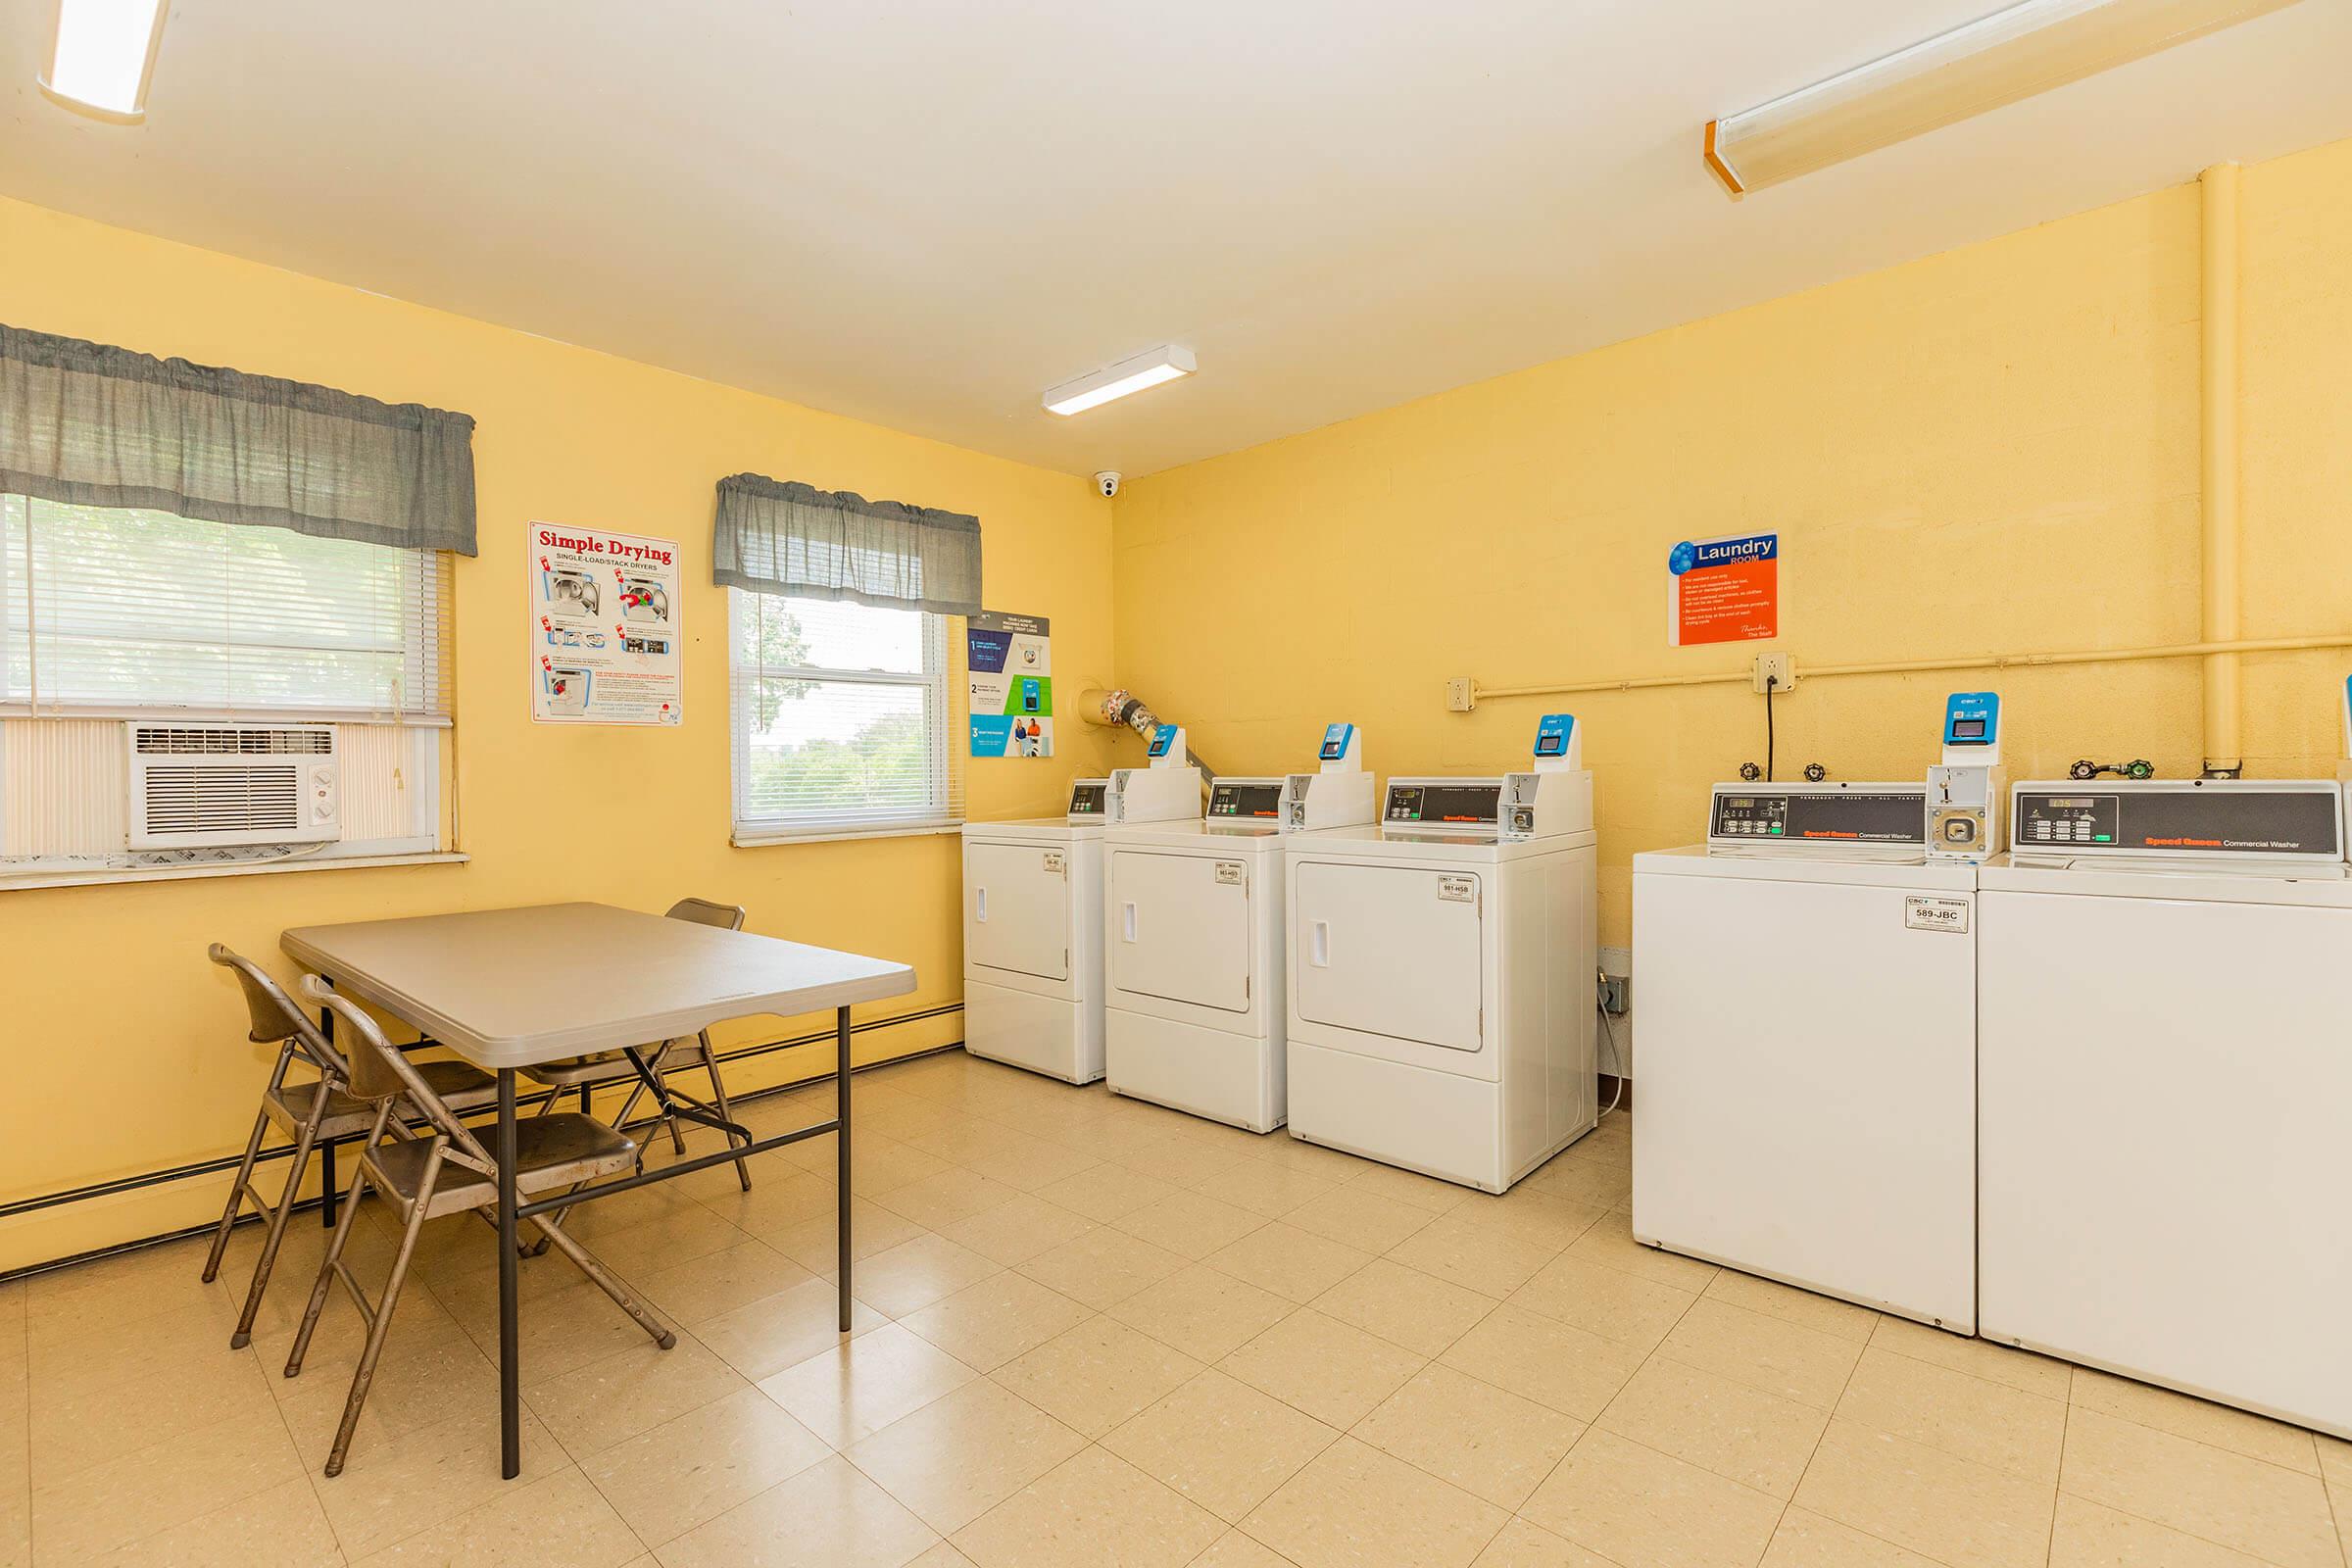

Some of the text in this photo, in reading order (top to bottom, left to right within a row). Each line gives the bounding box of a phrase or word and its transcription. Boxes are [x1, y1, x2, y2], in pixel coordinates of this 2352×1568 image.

[539, 530, 672, 565] Simple Drying
[1698, 539, 1773, 561] Laundry
[556, 553, 629, 568] SINGLE-LOAD/STACK
[630, 562, 658, 571] DRYERS
[1730, 554, 1760, 564] ROOM
[971, 640, 975, 651] 1
[971, 684, 977, 693] 2
[972, 727, 978, 737] 3
[2145, 837, 2182, 846] Speed
[2223, 839, 2270, 848] Commercial
[1916, 909, 1958, 920] 589-JBC
